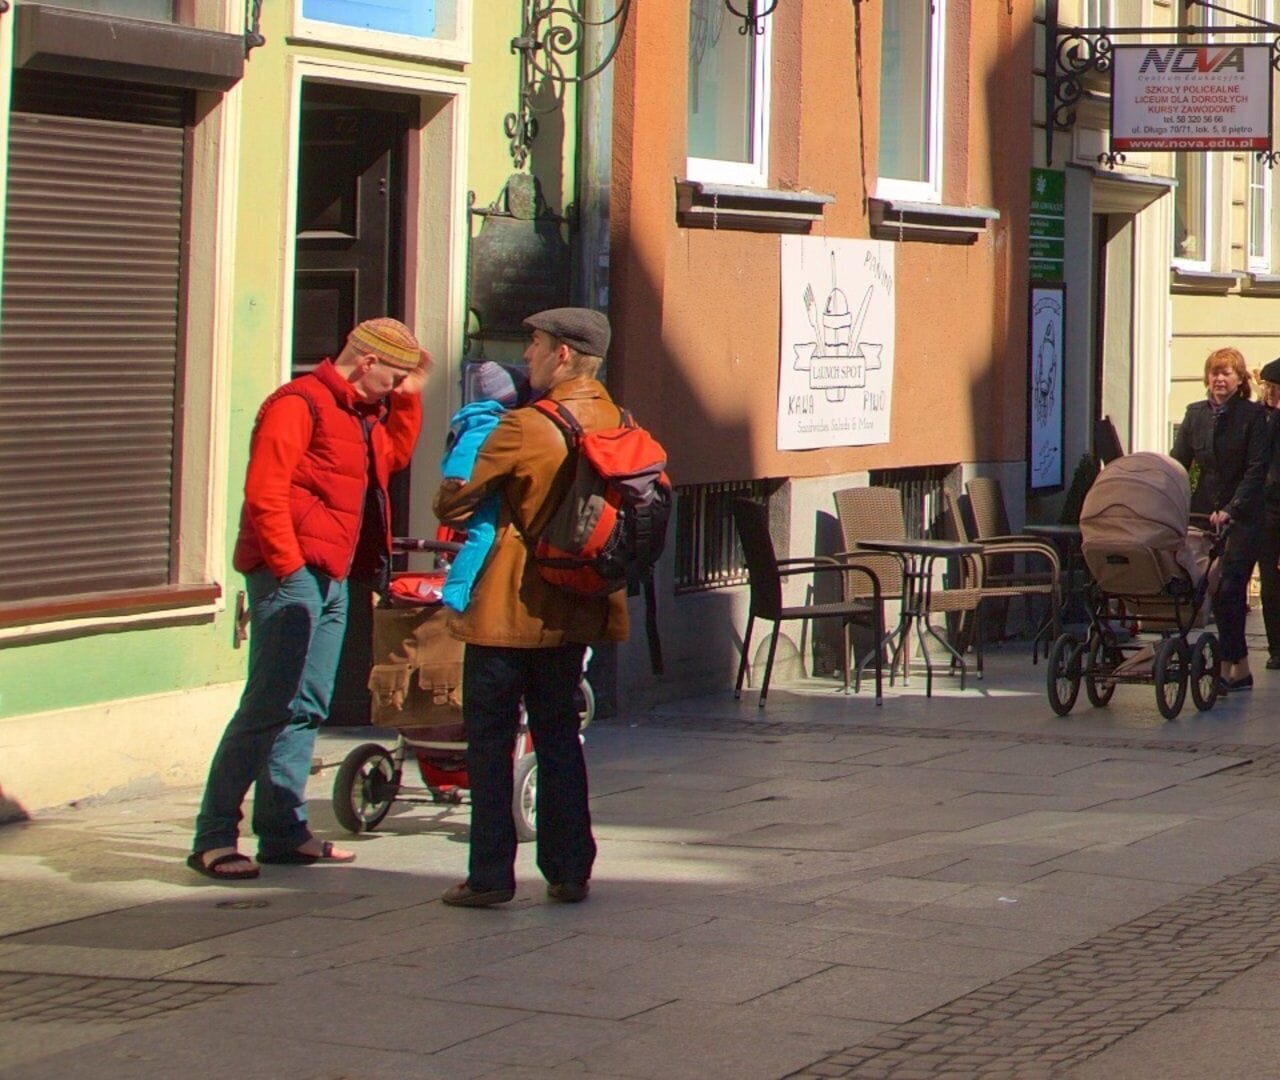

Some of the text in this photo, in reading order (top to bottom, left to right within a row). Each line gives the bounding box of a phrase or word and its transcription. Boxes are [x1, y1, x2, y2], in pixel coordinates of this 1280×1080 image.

[1138, 48, 1245, 73] NOVA
[1145, 84, 1240, 94] SZKOŁY POLICEALNE
[1135, 95, 1248, 104] LICEUM DLA DOROSŁYCH
[1148, 105, 1236, 114] KURSY ZAWODOWE
[1129, 138, 1253, 149] www.nova.edu.pl
[841, 365, 862, 379] SPOT
[788, 393, 814, 416] KAWA
[863, 390, 886, 412] PIWO
